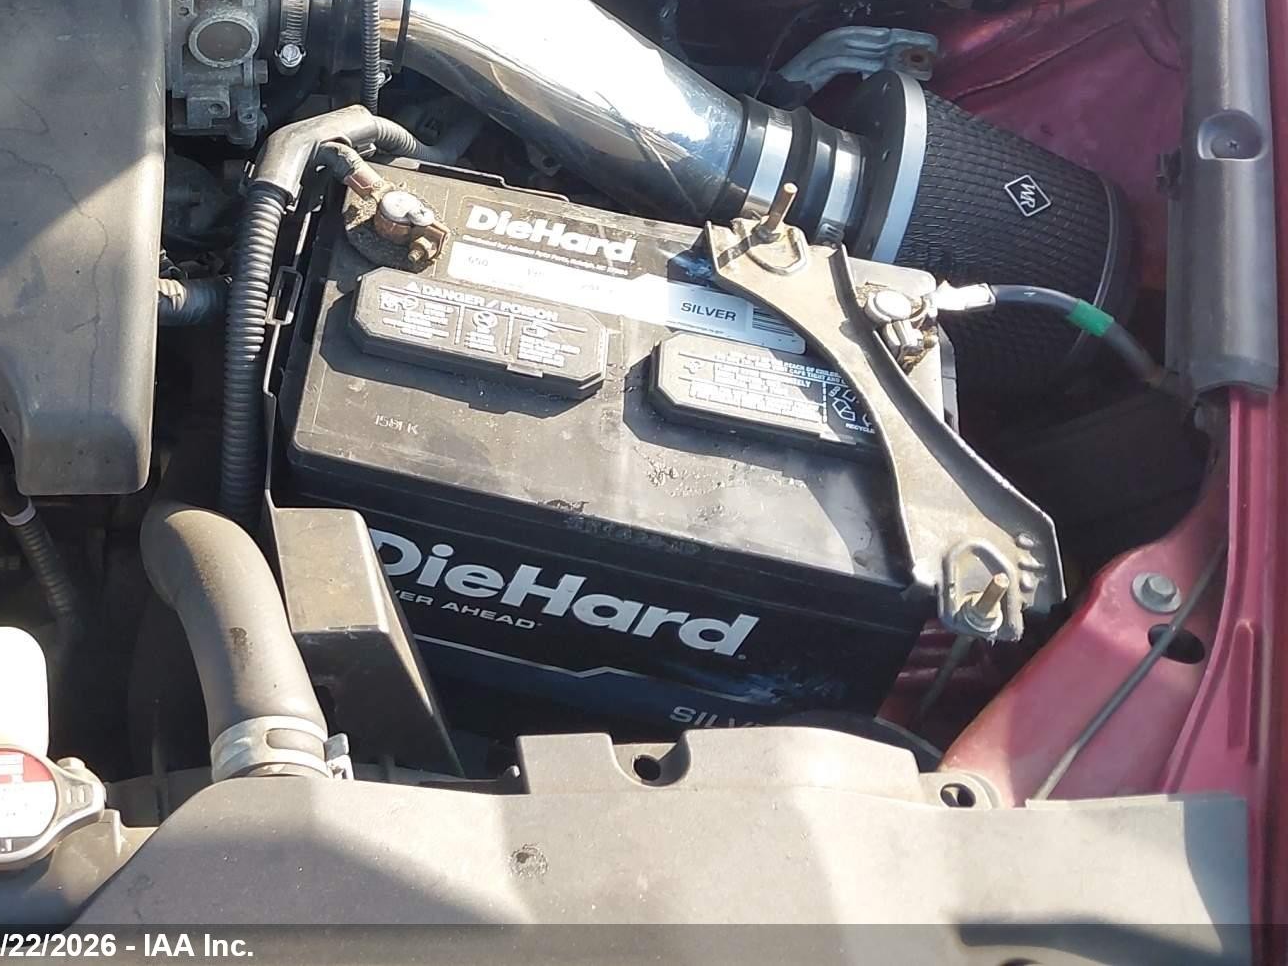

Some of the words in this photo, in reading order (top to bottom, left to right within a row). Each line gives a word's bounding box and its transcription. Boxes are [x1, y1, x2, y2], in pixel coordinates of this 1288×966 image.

[465, 204, 638, 264] DieHard
[420, 286, 486, 308] DANGER
[500, 301, 559, 323] POISON
[680, 301, 737, 323] SILVER
[369, 527, 760, 657] DieHard
[441, 601, 537, 630] AHEAD
